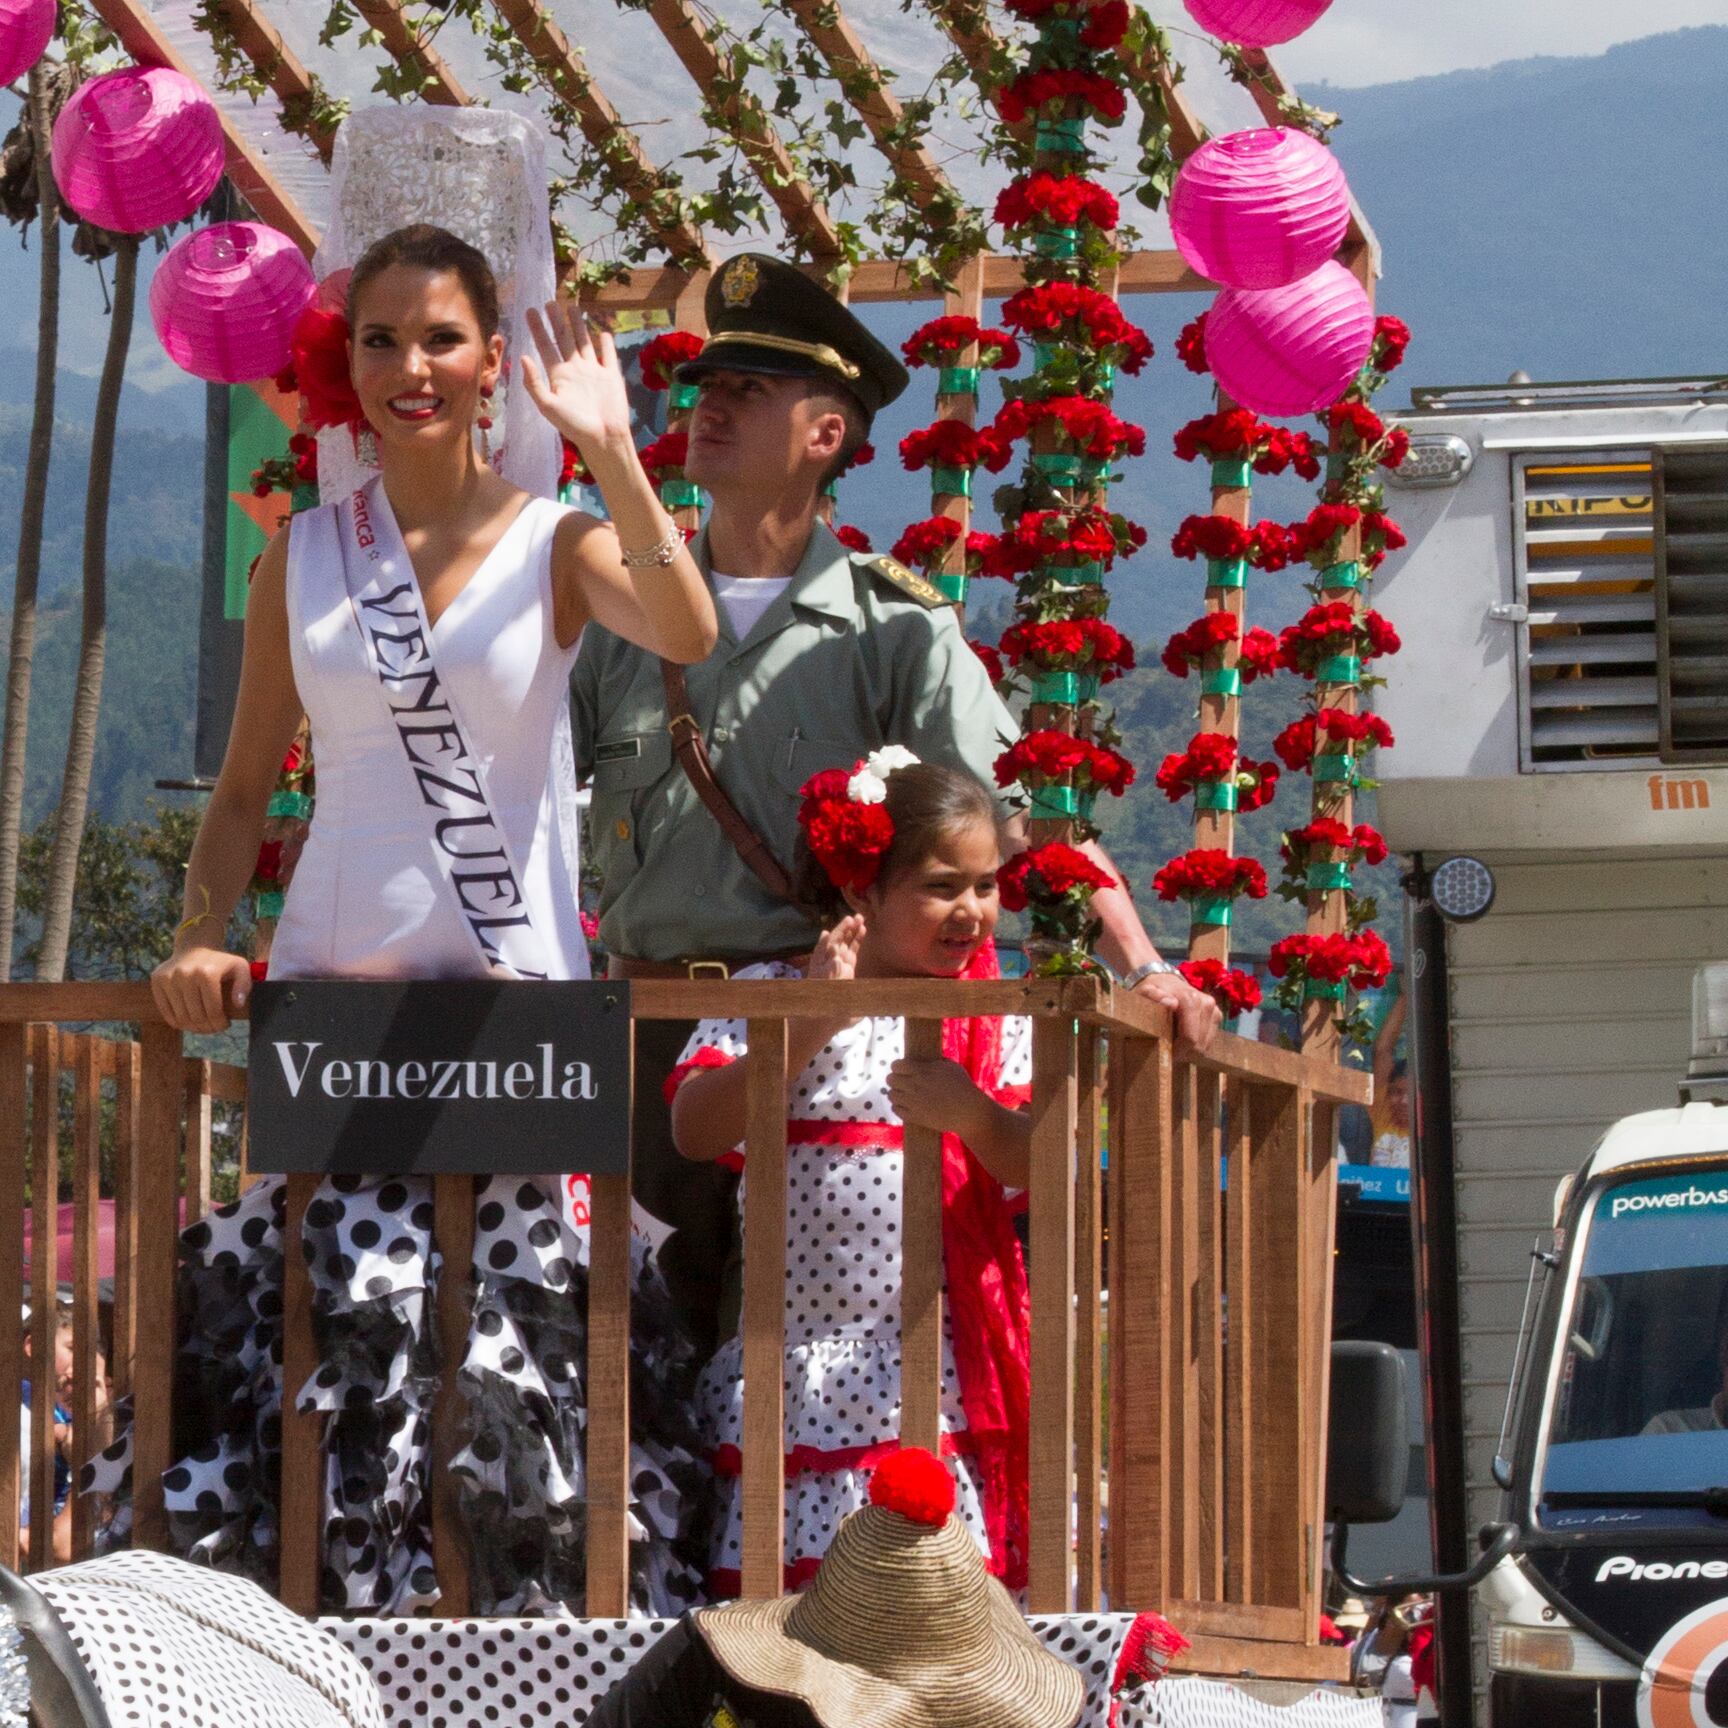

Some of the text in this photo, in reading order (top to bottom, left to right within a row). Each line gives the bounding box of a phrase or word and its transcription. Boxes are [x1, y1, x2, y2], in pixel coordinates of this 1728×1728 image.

[360, 581, 548, 980] VENEZUEL
[1647, 774, 1710, 811] fm
[273, 1041, 598, 1101] Venezuela
